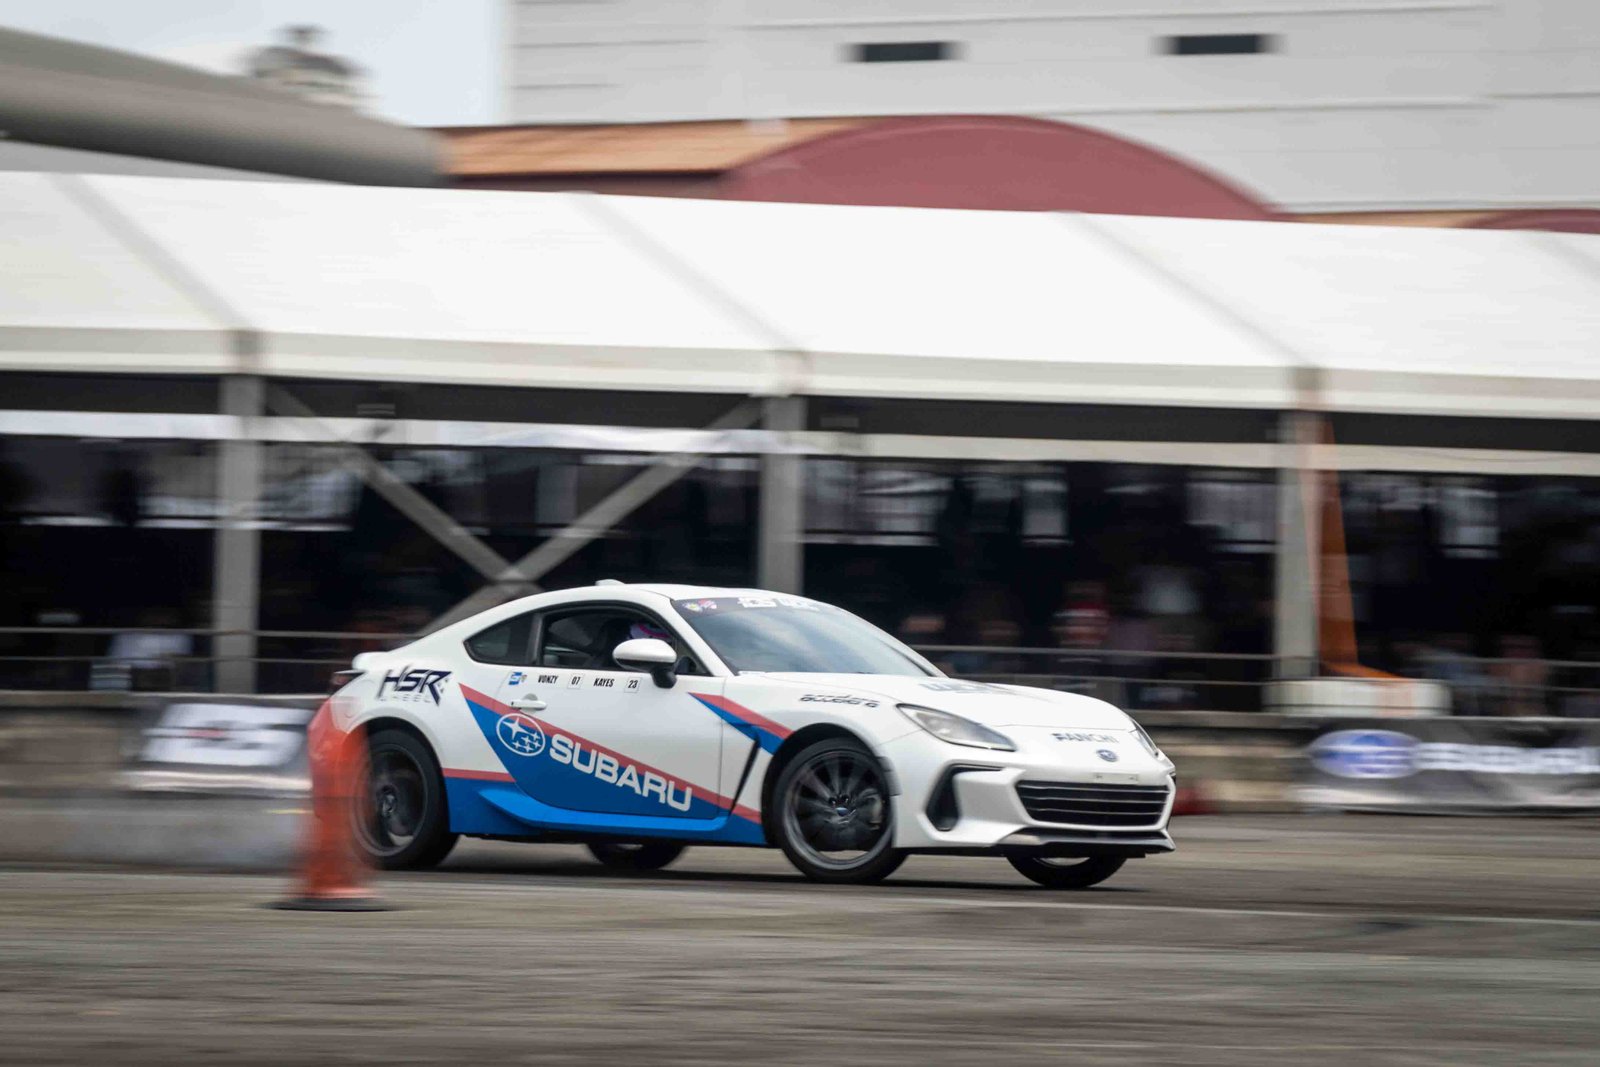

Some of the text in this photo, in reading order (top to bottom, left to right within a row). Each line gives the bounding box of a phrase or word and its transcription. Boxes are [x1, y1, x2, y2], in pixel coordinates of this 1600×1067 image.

[376, 664, 452, 706] HSR
[538, 675, 558, 684] VONZY
[571, 676, 581, 685] 07
[593, 678, 615, 687] KAYES
[628, 680, 638, 689] 23
[549, 733, 693, 812] SUBARU
